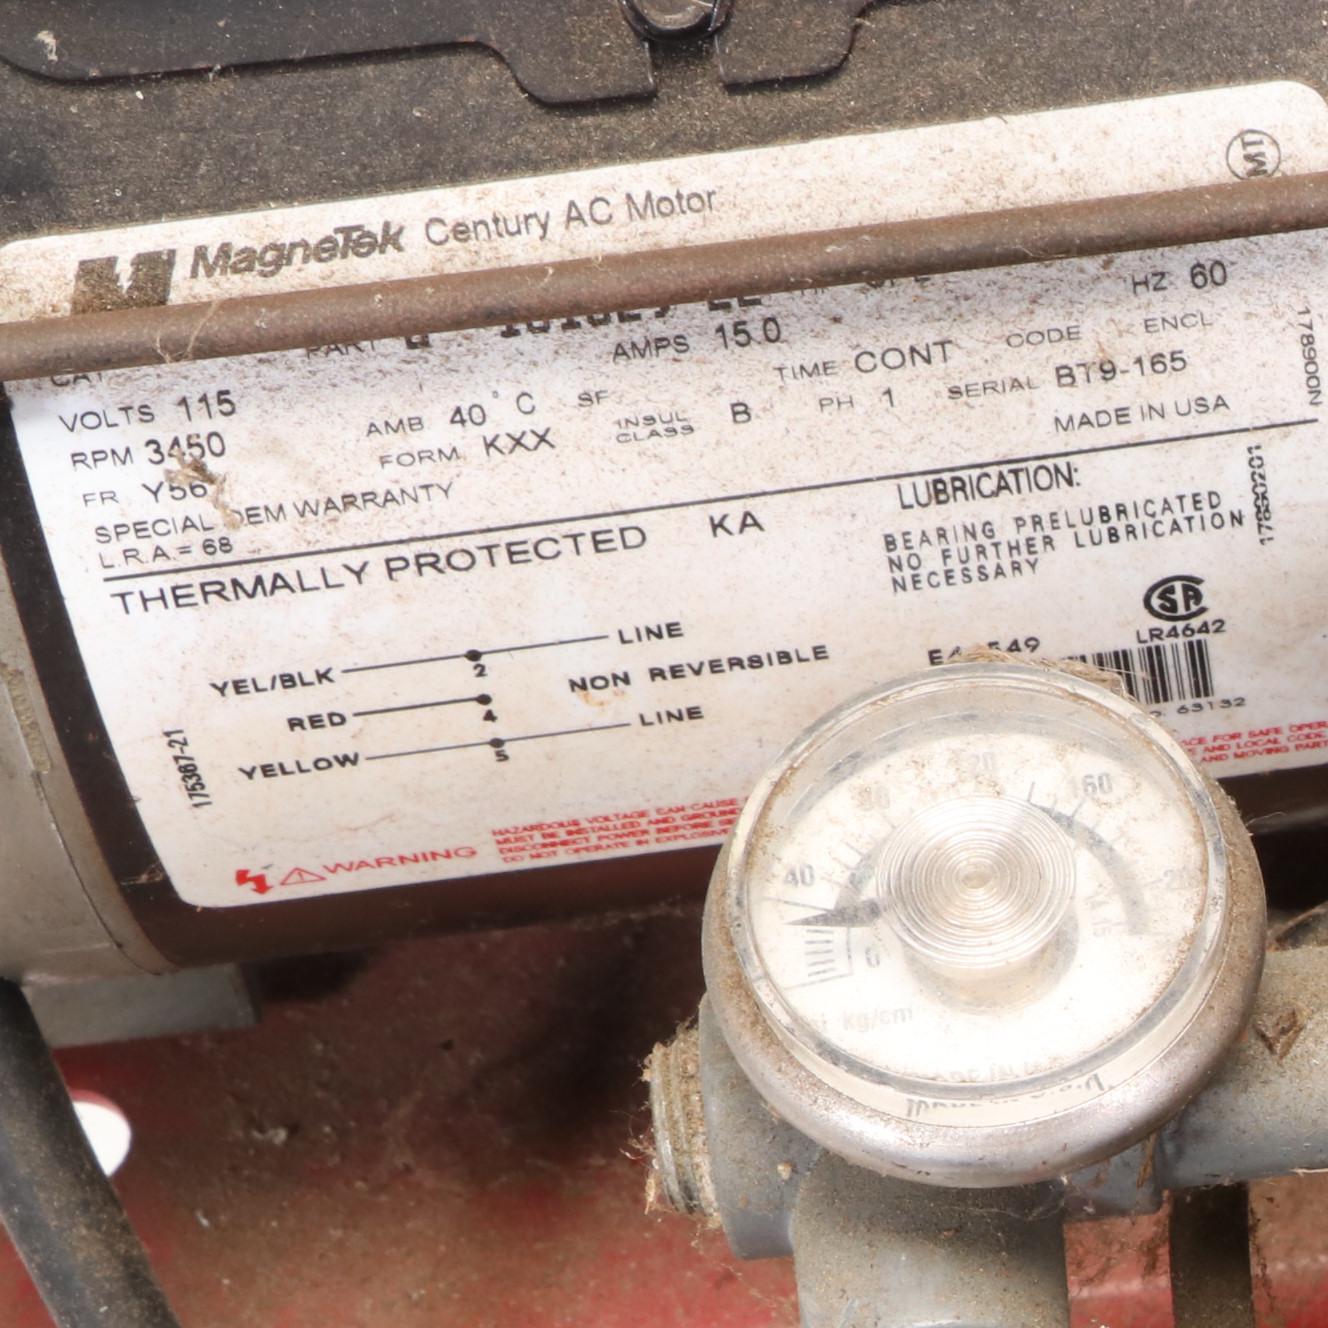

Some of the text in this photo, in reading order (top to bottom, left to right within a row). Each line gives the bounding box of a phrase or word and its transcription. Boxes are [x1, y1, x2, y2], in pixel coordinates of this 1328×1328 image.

[190, 189, 716, 279] MagneTek Century AC Motor
[1131, 261, 1228, 294] HZ 60
[1006, 312, 1213, 347] CODE ENCL
[613, 335, 690, 363] AMPS
[773, 340, 953, 381] TIME CONT
[1297, 306, 1323, 405] 178900N
[948, 350, 1187, 400] SERIAL BT9-165
[59, 390, 236, 432] VOLTS 115
[366, 417, 424, 437] AMB
[577, 390, 609, 407] SF
[730, 402, 751, 424] B
[819, 387, 895, 413] PH 1
[1055, 394, 1230, 433] MADE IN USA
[616, 411, 689, 429] INSUL
[616, 425, 695, 444] CLASS
[70, 431, 227, 472] RPM 3450
[379, 426, 556, 469] FORM KXX
[82, 480, 208, 507] FR Y56
[897, 461, 1081, 510] LUBRICATION:
[94, 482, 453, 544] SPECIAL WARRANTY
[883, 490, 1223, 553] BEARING PRELUBRICATED
[202, 537, 233, 557] 68
[887, 510, 1245, 574] NO FURTHER LUBRICATION
[110, 510, 765, 615] THERMALLY PROTECTED KA
[891, 558, 1041, 593] NECESSARY
[617, 622, 685, 645] LINE
[1136, 619, 1227, 644] LR4642
[210, 667, 337, 698] YEL/BLK
[473, 663, 488, 678] 2
[567, 645, 830, 694] NON REVERSIBLE
[287, 711, 347, 732] RED
[483, 709, 498, 722] 4
[639, 705, 705, 727] LINE
[1177, 697, 1247, 715] 63132
[239, 752, 360, 781] YELLOW
[495, 749, 510, 762] 5
[323, 845, 478, 874] WARNING
[784, 864, 815, 889] 40
